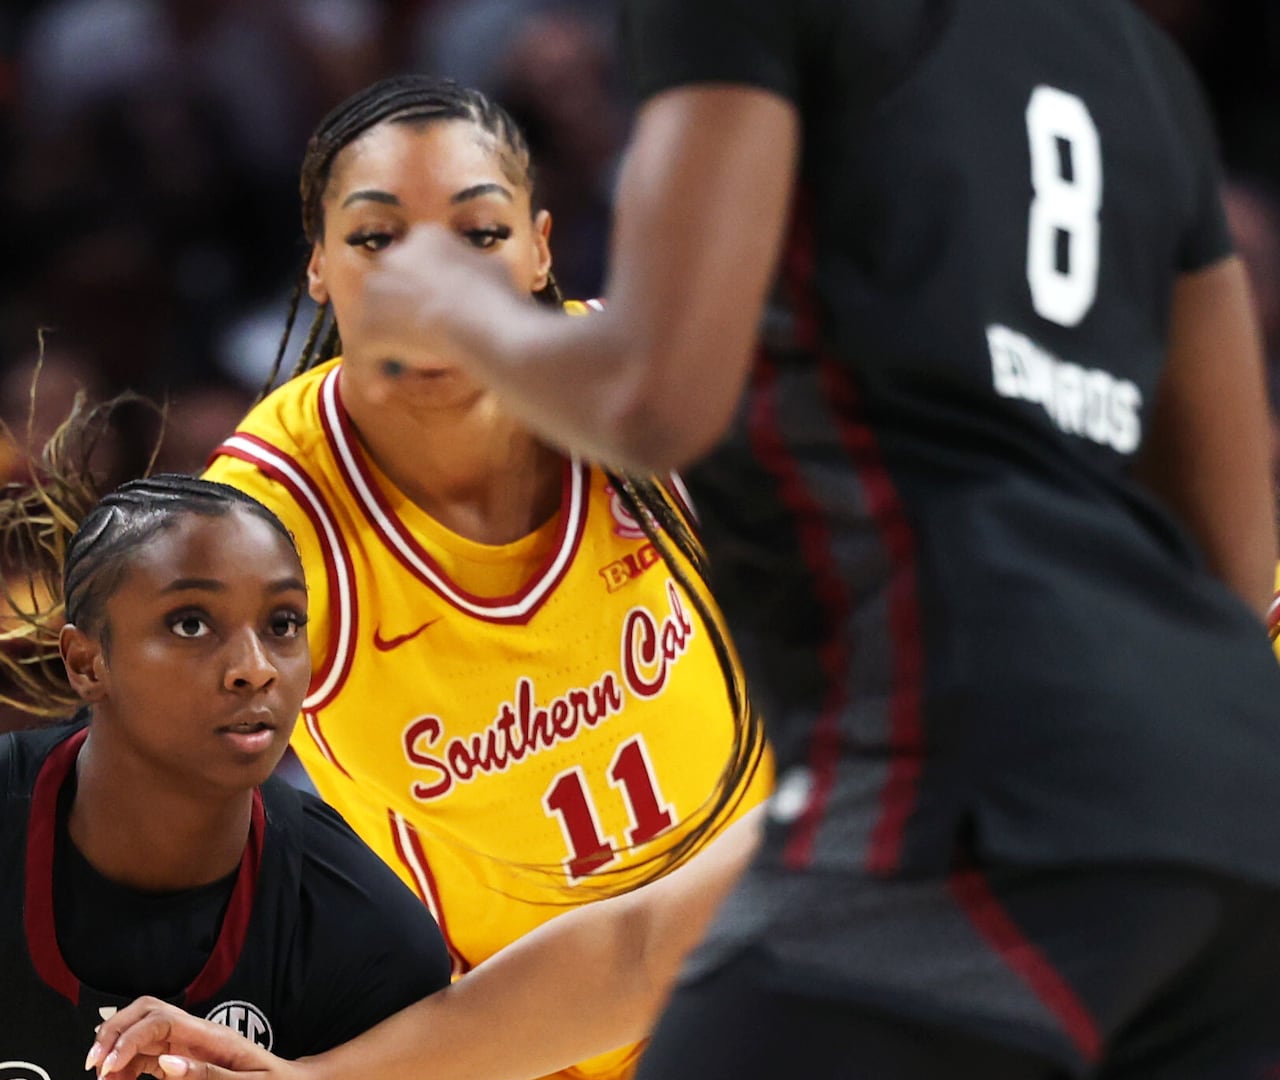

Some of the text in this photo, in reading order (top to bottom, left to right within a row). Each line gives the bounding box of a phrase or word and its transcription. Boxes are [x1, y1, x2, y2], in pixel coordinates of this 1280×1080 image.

[1025, 83, 1103, 328] 8
[402, 580, 695, 801] Southern Cal
[543, 733, 677, 886] 11
